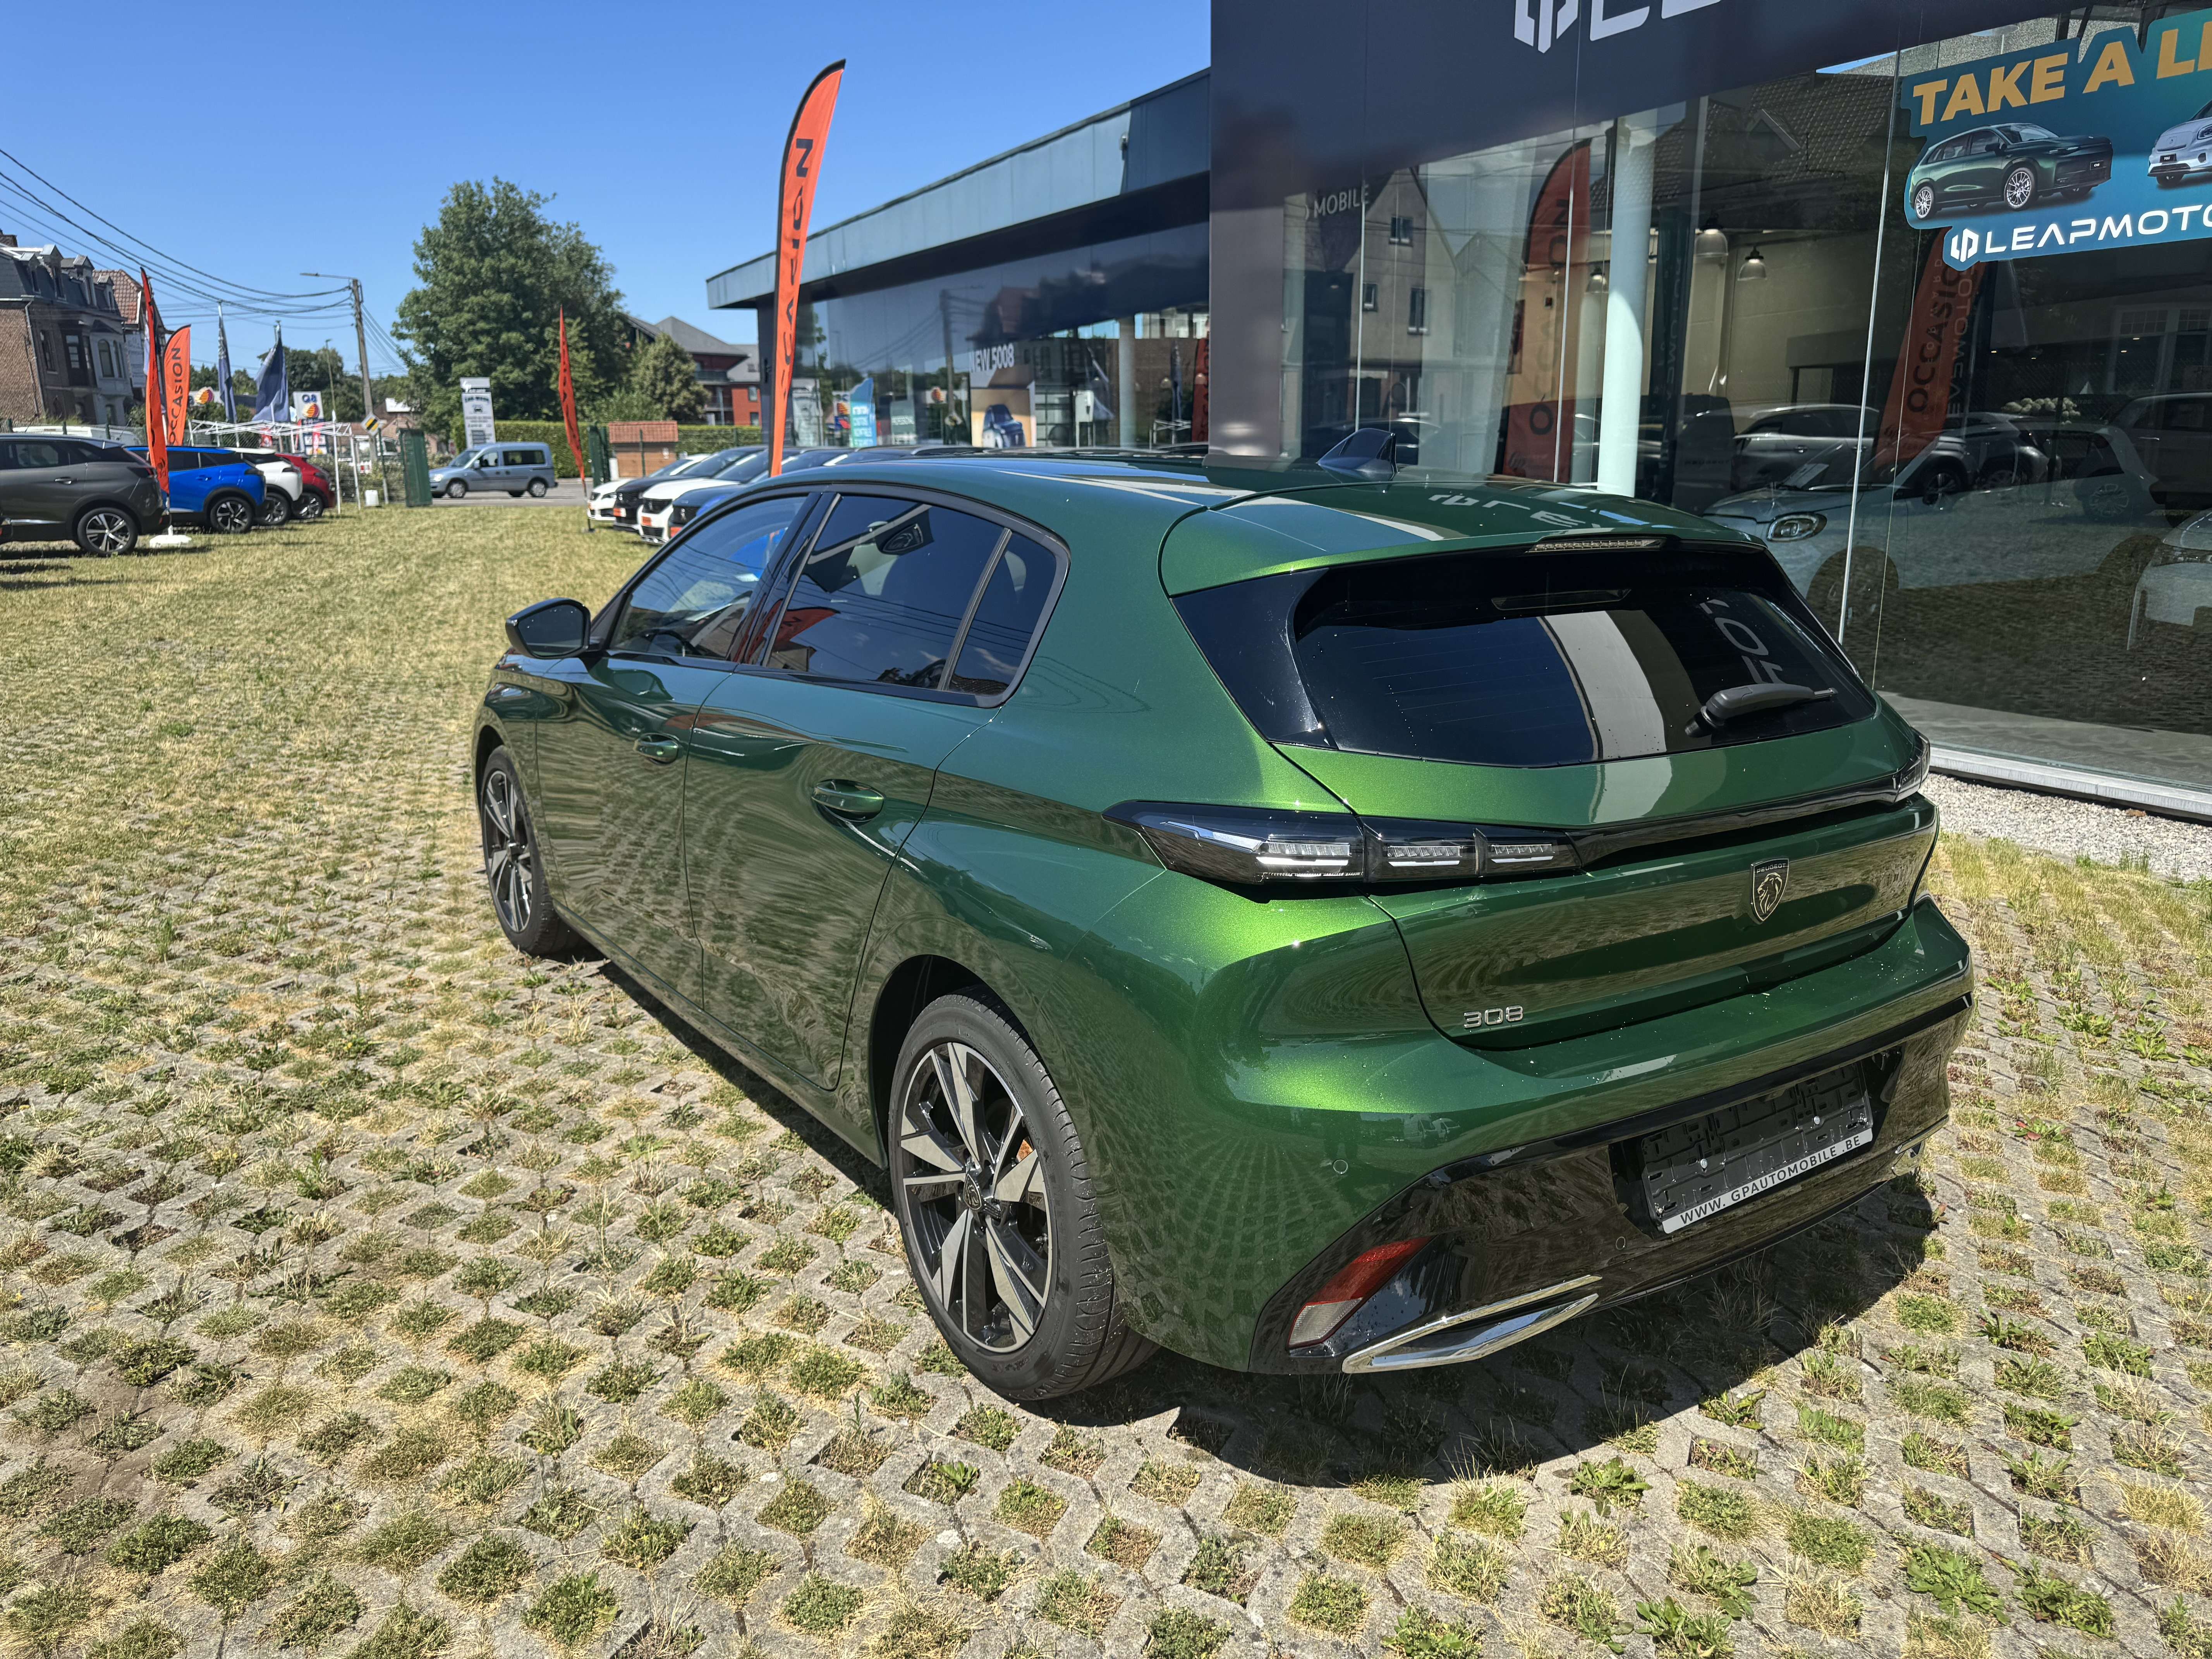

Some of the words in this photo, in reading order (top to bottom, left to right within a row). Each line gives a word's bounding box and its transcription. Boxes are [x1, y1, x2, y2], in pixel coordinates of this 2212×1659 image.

[1913, 52, 2068, 125] TAKE
[2082, 41, 2135, 94] A
[992, 343, 1014, 369] 5008
[1907, 266, 1961, 413] OCCASIO
[169, 348, 183, 444] OCCASION
[1756, 863, 1786, 874] PEUGEOT
[1464, 1005, 1523, 1028] 308
[1680, 1197, 1726, 1225] WWW.
[1731, 1146, 1837, 1202] GPAUTOMOBILE
